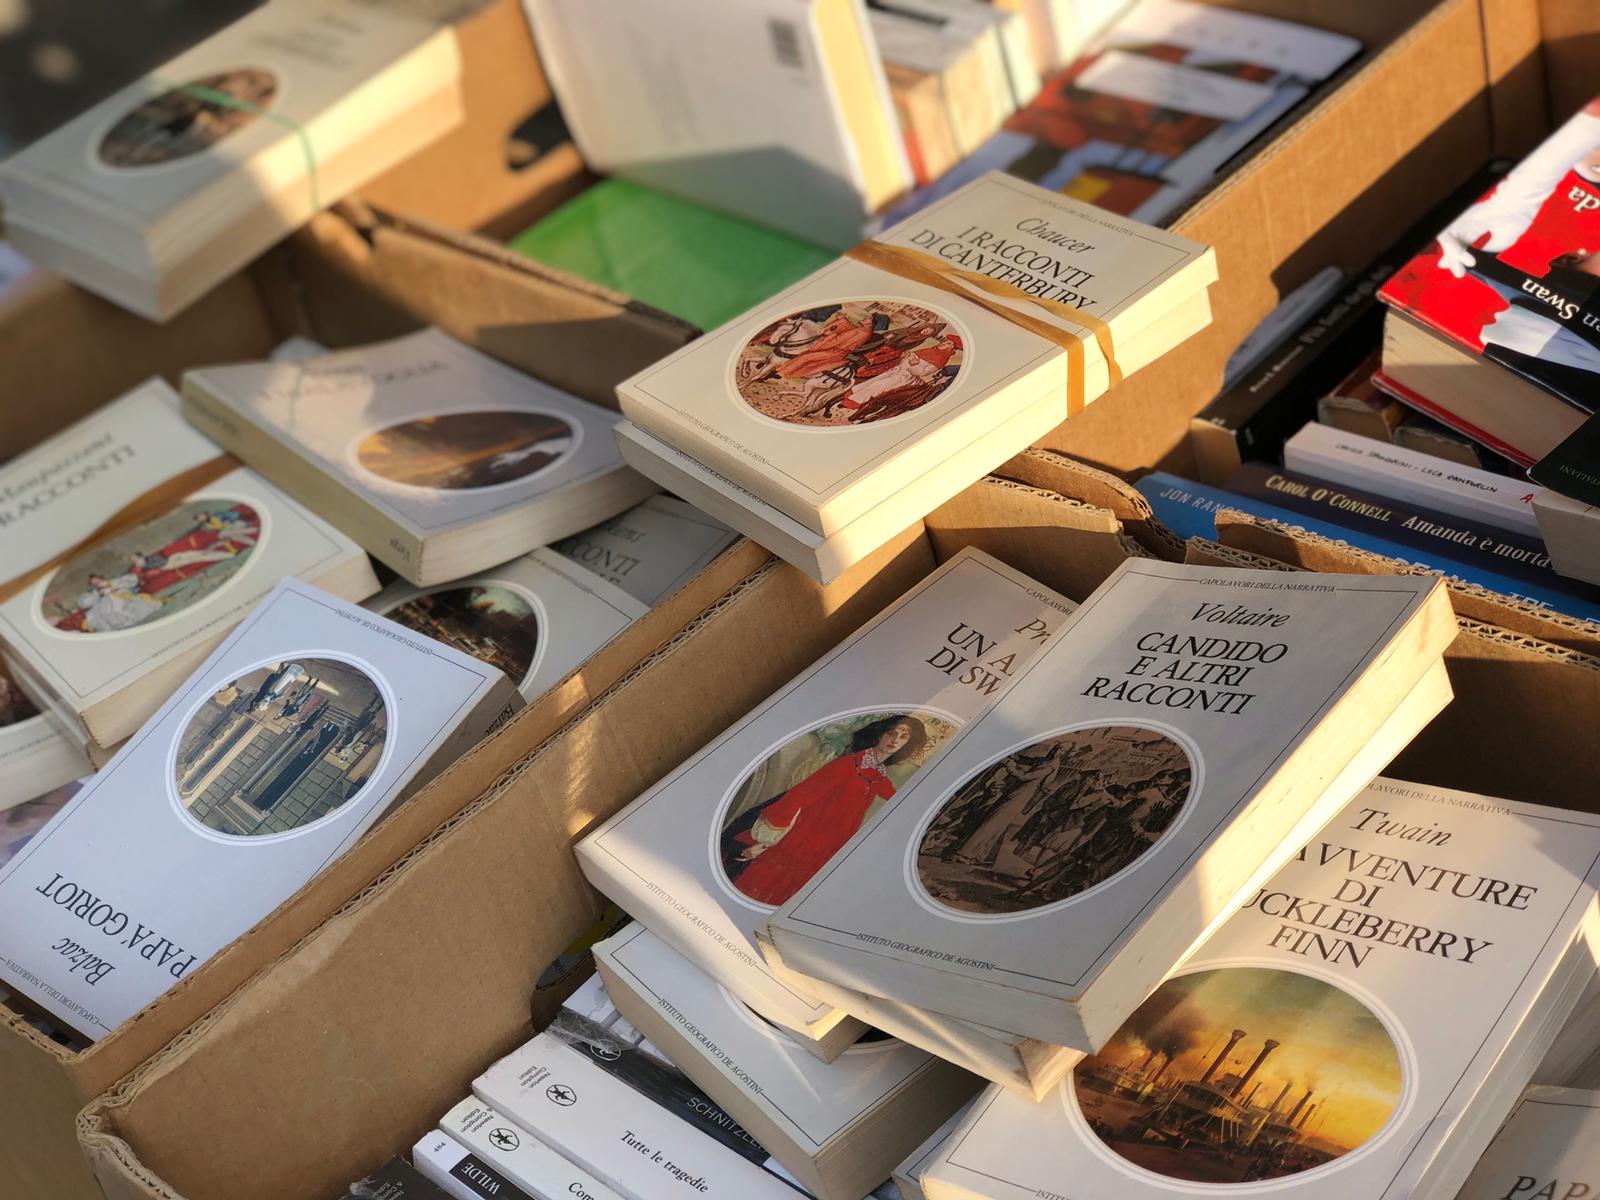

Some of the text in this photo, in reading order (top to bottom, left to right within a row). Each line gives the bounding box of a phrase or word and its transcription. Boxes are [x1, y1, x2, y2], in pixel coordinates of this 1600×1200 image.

[1016, 217, 1095, 253] Chaucer
[910, 229, 1097, 310] DI CANTERBURY
[957, 226, 1095, 288] I RACCONTI
[1522, 278, 1580, 320] Swan
[1159, 488, 1193, 504] JON
[1265, 474, 1551, 568] CAROL O'CONNELL Amanda è morta
[570, 544, 641, 577] CONTI
[1025, 588, 1073, 616] CAPOLAVORI
[1200, 579, 1334, 593] CAPOLAVORI DELLA NARRATIVA
[1190, 602, 1291, 628] Voltaire
[405, 639, 433, 655] ISTITUTO
[947, 622, 1017, 676] UN A
[1136, 632, 1289, 664] CANDIDO
[925, 646, 1001, 696] DI SW
[1125, 655, 1255, 687] E ALTRI
[1080, 676, 1256, 715] RACCONTI
[484, 703, 514, 737] Balzac
[1410, 791, 1445, 804] DELLA
[1447, 797, 1511, 816] NARRATIVA
[1350, 807, 1453, 847] Twain
[35, 873, 129, 936] GORIOT
[1331, 879, 1385, 909] DI
[647, 882, 756, 968] ISTITUTO GEOGRAFICO DE AGOSTINI
[1241, 888, 1494, 964] UCKLEBERRY
[51, 937, 116, 986] Balzac
[856, 933, 995, 971] ISTITUTO GEOGRAFICO DE AGOSTINI
[1267, 925, 1374, 969] FINN
[5, 959, 99, 1025] CAPOLAVORI DELLA NARRATIVA
[658, 998, 762, 1095] ISTITUTO GEOGRAFICO DE AGOSTINI
[519, 1065, 537, 1080] Editori
[520, 1066, 547, 1087] Compton
[529, 1071, 551, 1088] Newton
[460, 1111, 487, 1132] Compton
[461, 1108, 481, 1123] Editori
[471, 1114, 494, 1132] Newton
[620, 1130, 710, 1193] Tutte le tragedie
[461, 1162, 501, 1195] WILDE
[568, 1182, 595, 1200] Com
[1500, 1176, 1600, 1200] PAP
